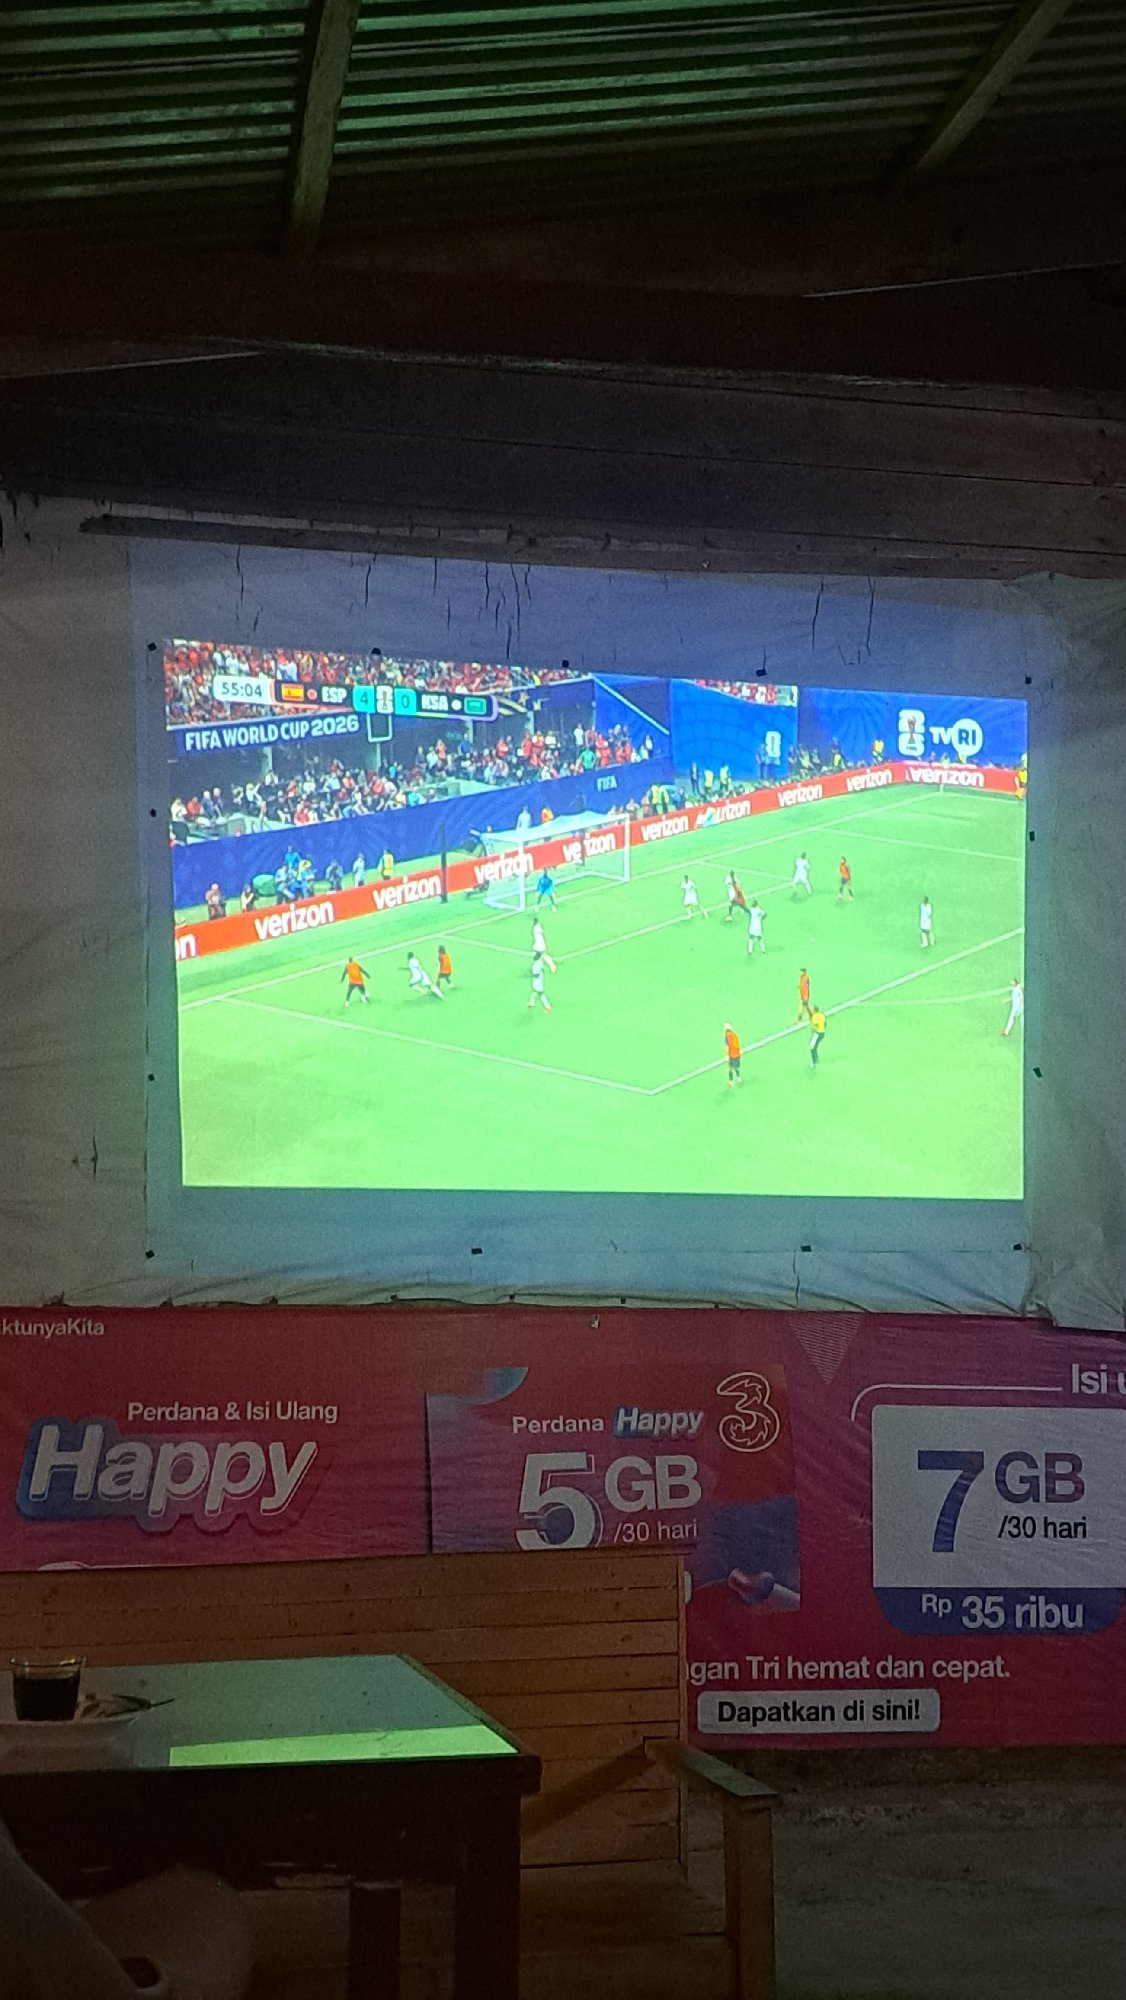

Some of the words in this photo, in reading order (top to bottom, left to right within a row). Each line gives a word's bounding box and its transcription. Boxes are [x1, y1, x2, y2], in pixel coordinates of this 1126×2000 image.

[221, 678, 262, 697] 55:04
[321, 686, 347, 703] ESP
[360, 692, 369, 706] 4
[401, 694, 410, 708] 0
[421, 694, 449, 710] KSA
[185, 730, 222, 750] FIFA
[223, 724, 278, 747] WORLD
[280, 720, 309, 740] CUP
[311, 715, 359, 737] 2026
[929, 722, 981, 751] TVRI
[777, 783, 822, 807] verizon
[847, 769, 892, 792] verizon
[641, 815, 688, 842] verizon
[562, 832, 616, 862] veizon
[474, 852, 534, 883] verizon
[373, 875, 442, 910] verizon
[255, 901, 334, 940] verizon
[0, 1318, 105, 1339] ktunyaKita
[1072, 1363, 1108, 1394] Isi
[127, 1402, 218, 1421] Perdana
[224, 1402, 240, 1420] &
[247, 1401, 270, 1420] Isi
[275, 1401, 338, 1424] Ulang
[512, 1415, 604, 1433] Perdana
[616, 1407, 704, 1438] Happy
[28, 1424, 319, 1518] Happy
[516, 1452, 599, 1550] 5
[604, 1455, 702, 1513] GB
[917, 1450, 984, 1552] 7
[995, 1451, 1085, 1503] GB
[613, 1522, 649, 1543] /30
[657, 1518, 697, 1540] hari
[998, 1515, 1036, 1539] /30
[1043, 1516, 1087, 1539] hari
[921, 1593, 952, 1617] Rp
[962, 1595, 1005, 1628] 35
[1015, 1595, 1083, 1628] ribu
[746, 1656, 780, 1680] Tri
[787, 1656, 871, 1680] hemat
[883, 1654, 924, 1679] dan
[932, 1655, 1010, 1683] cepat.
[718, 1701, 835, 1727] Dapatkan
[843, 1700, 865, 1722] di
[872, 1698, 921, 1721] sini!
